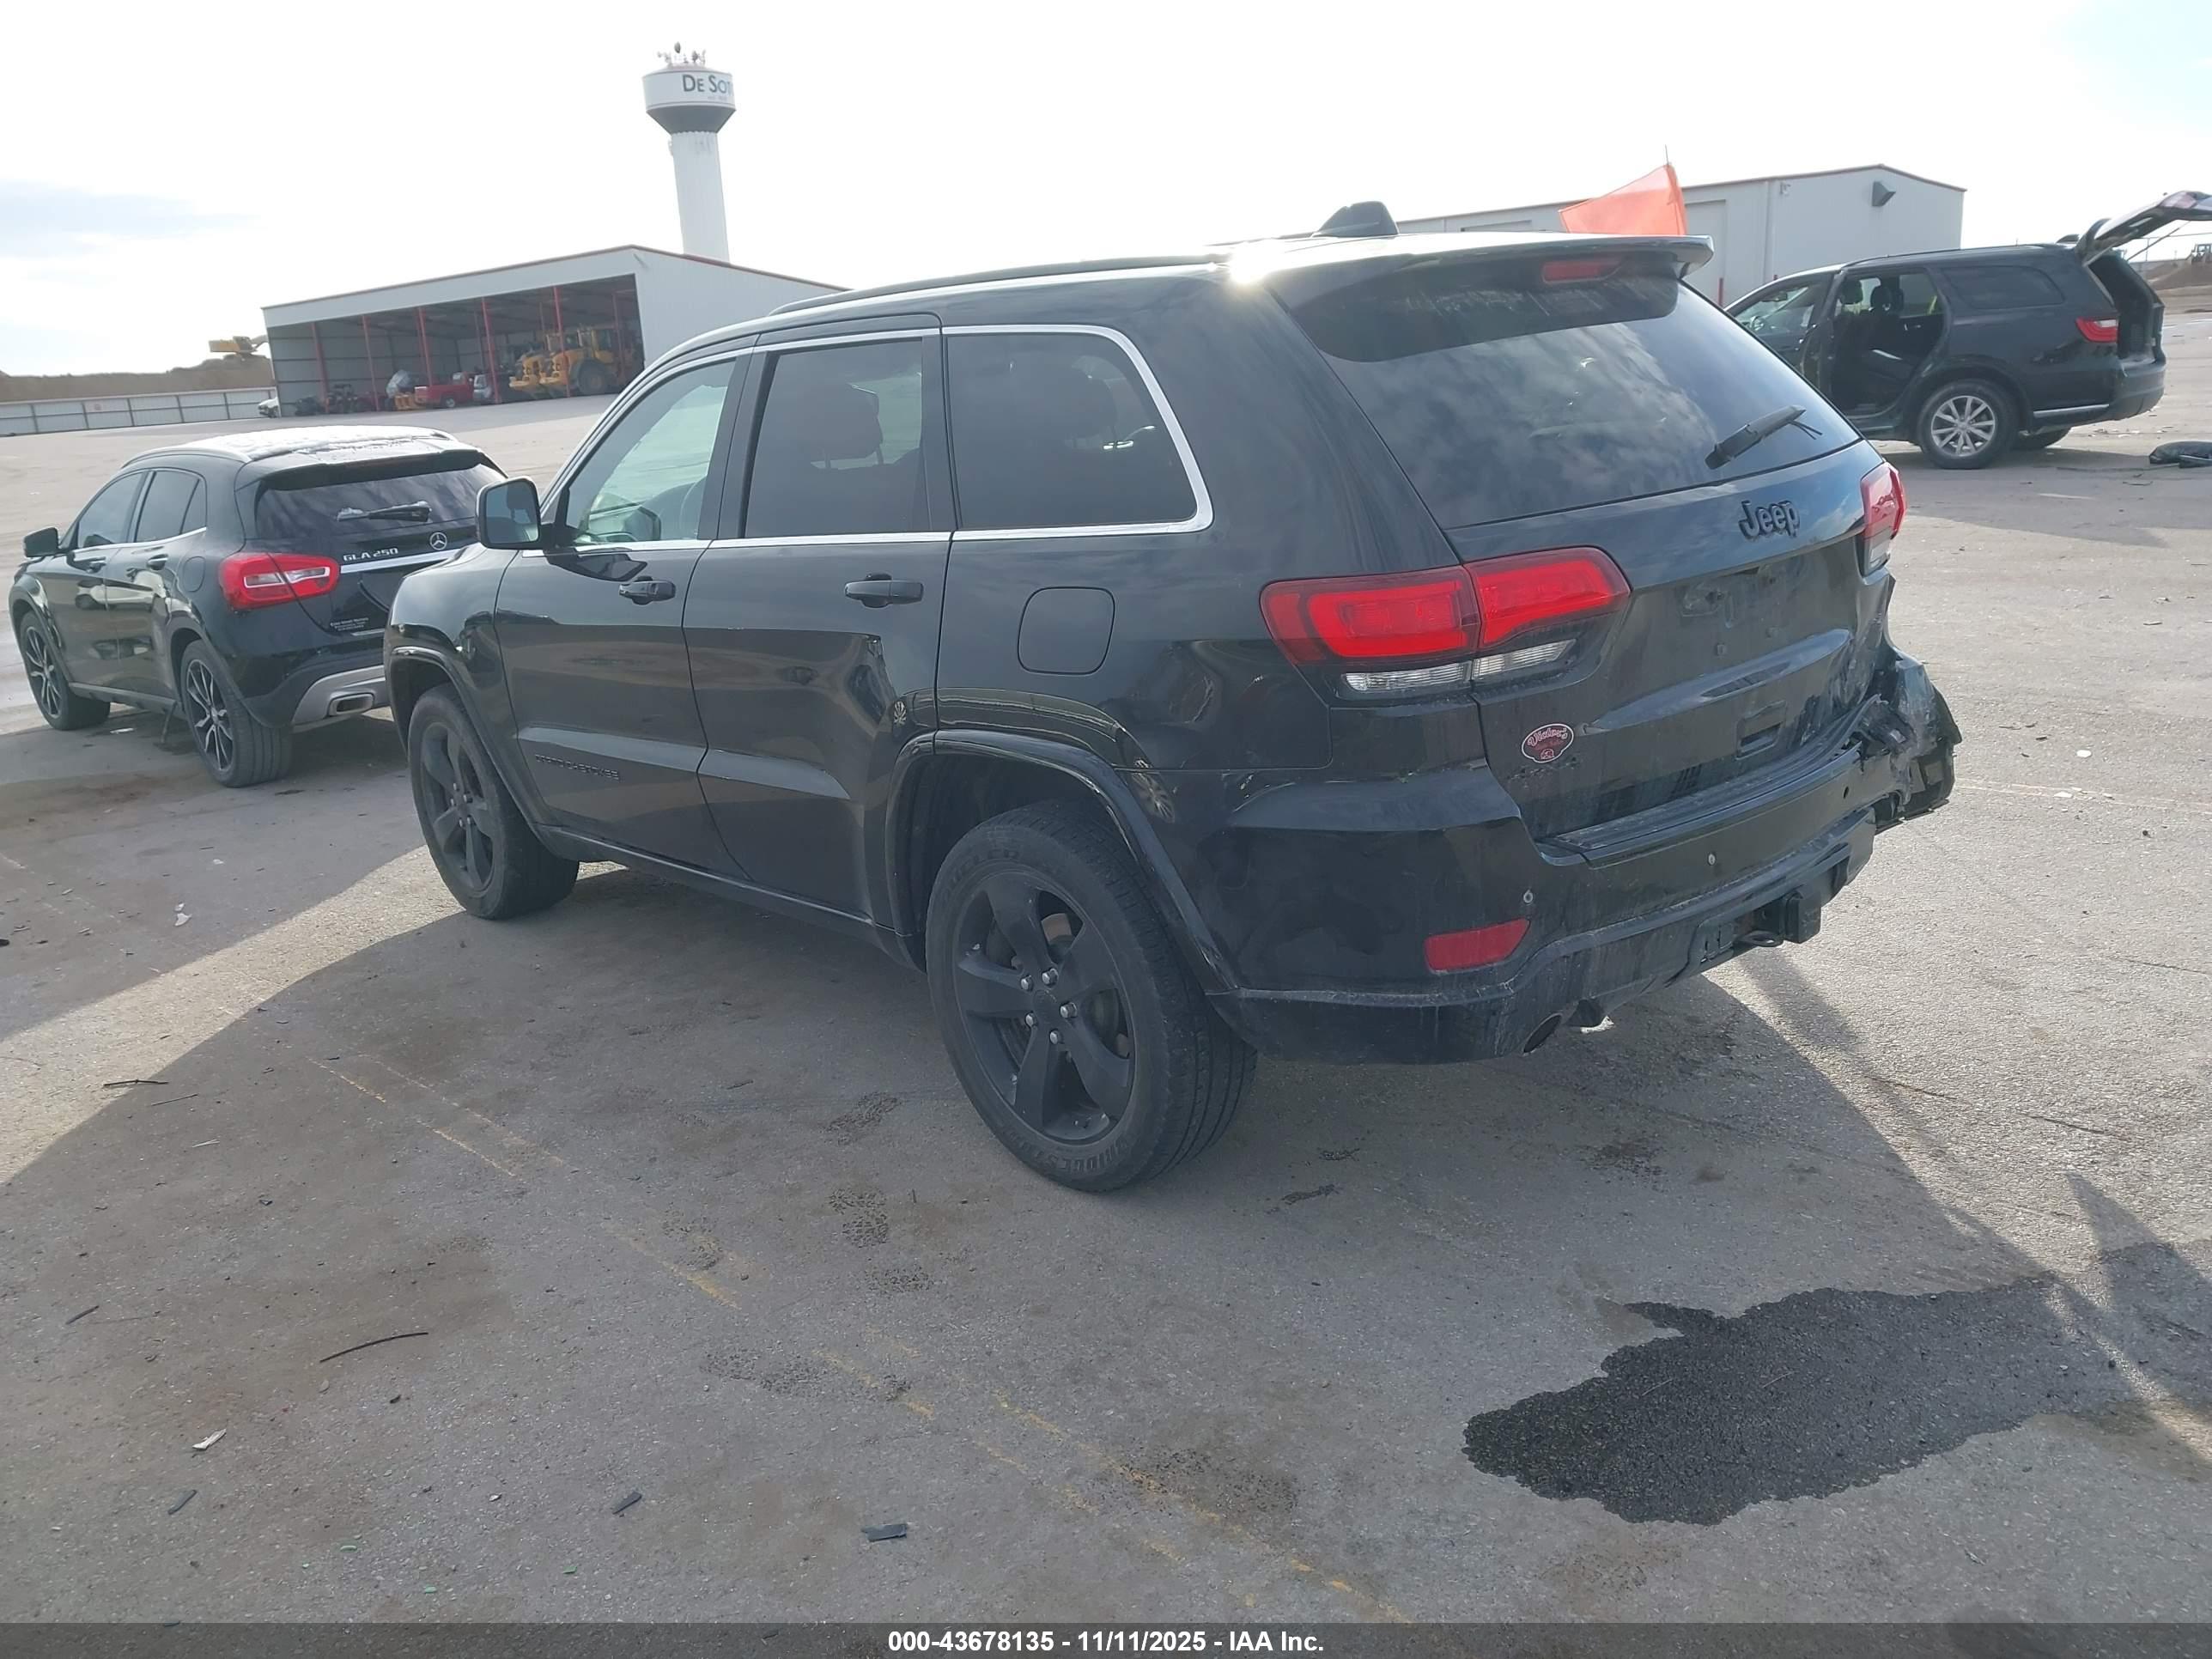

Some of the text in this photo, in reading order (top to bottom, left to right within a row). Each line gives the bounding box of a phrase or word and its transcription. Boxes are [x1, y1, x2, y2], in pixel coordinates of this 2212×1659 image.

[1738, 500, 1800, 540] Jeep
[343, 547, 398, 562] GLA 250
